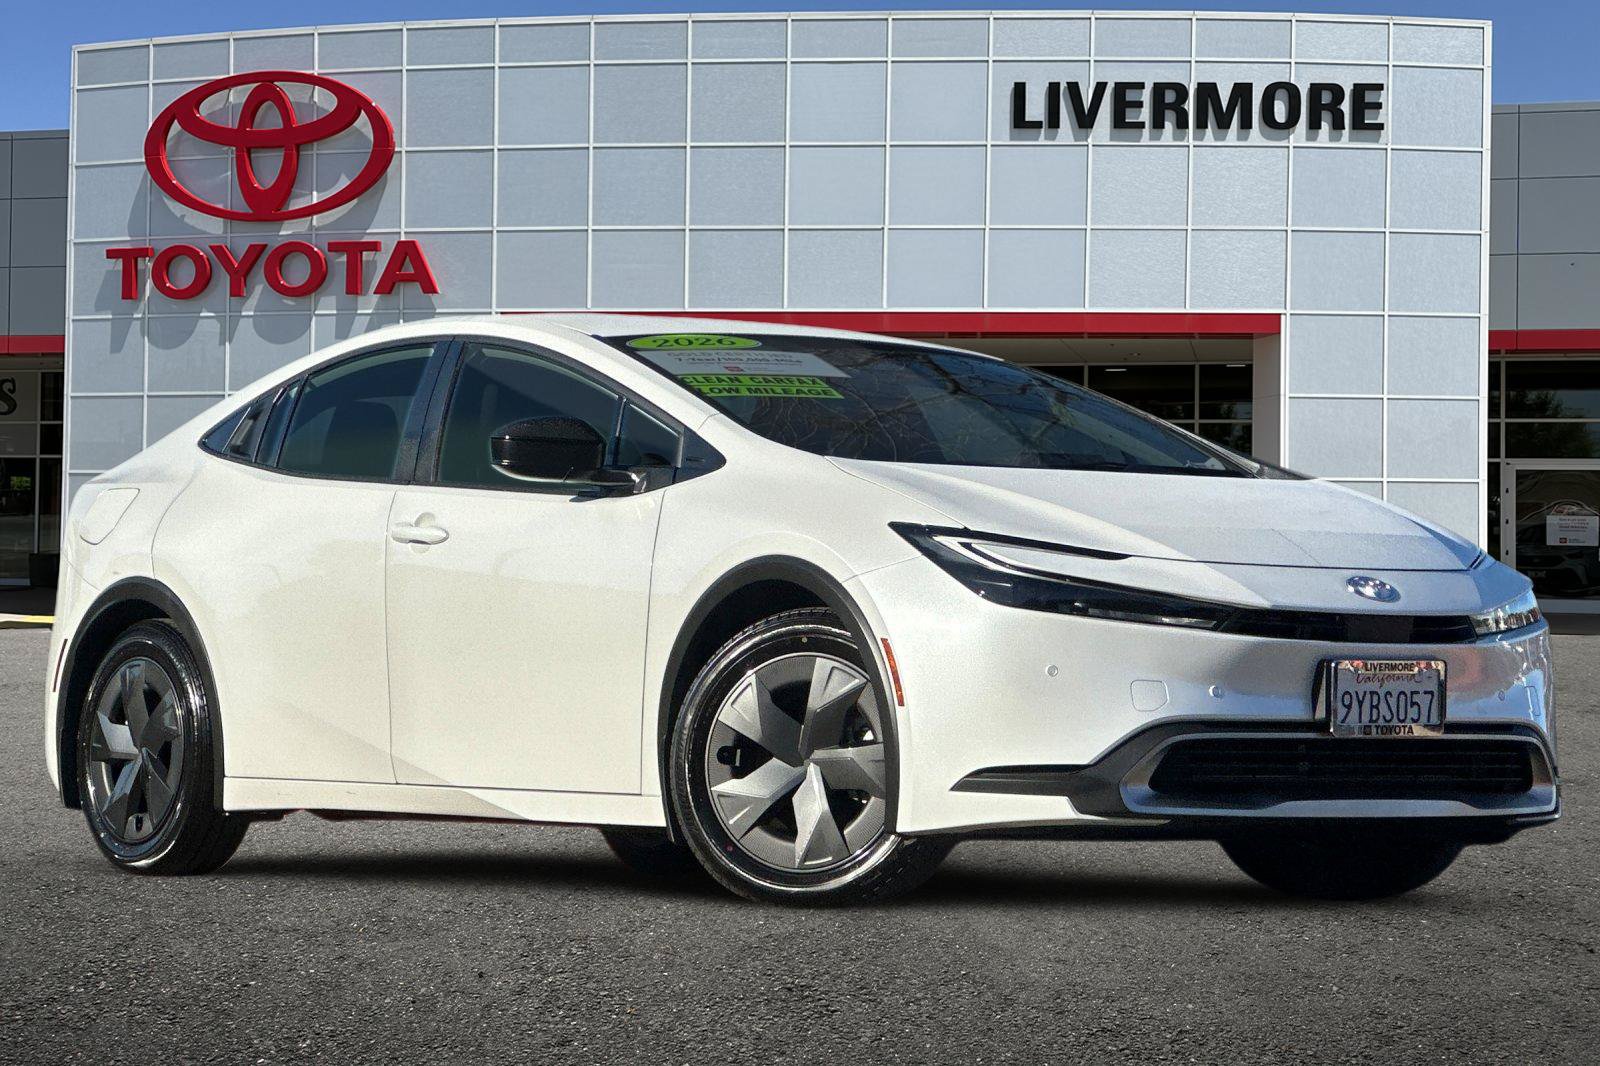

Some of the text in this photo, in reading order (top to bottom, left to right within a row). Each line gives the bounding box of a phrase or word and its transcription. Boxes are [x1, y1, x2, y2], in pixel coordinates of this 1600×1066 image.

[1013, 81, 1385, 131] LIVERMORE
[105, 240, 440, 300] TOYOTA
[652, 338, 737, 348] 2026
[680, 375, 824, 386] CLEAN CARFAX
[697, 386, 835, 397] LOW MILEAGE
[1364, 662, 1416, 672] LIVERMORE
[1340, 690, 1435, 724] 9YBS057
[1375, 724, 1415, 736] TOYOTA
